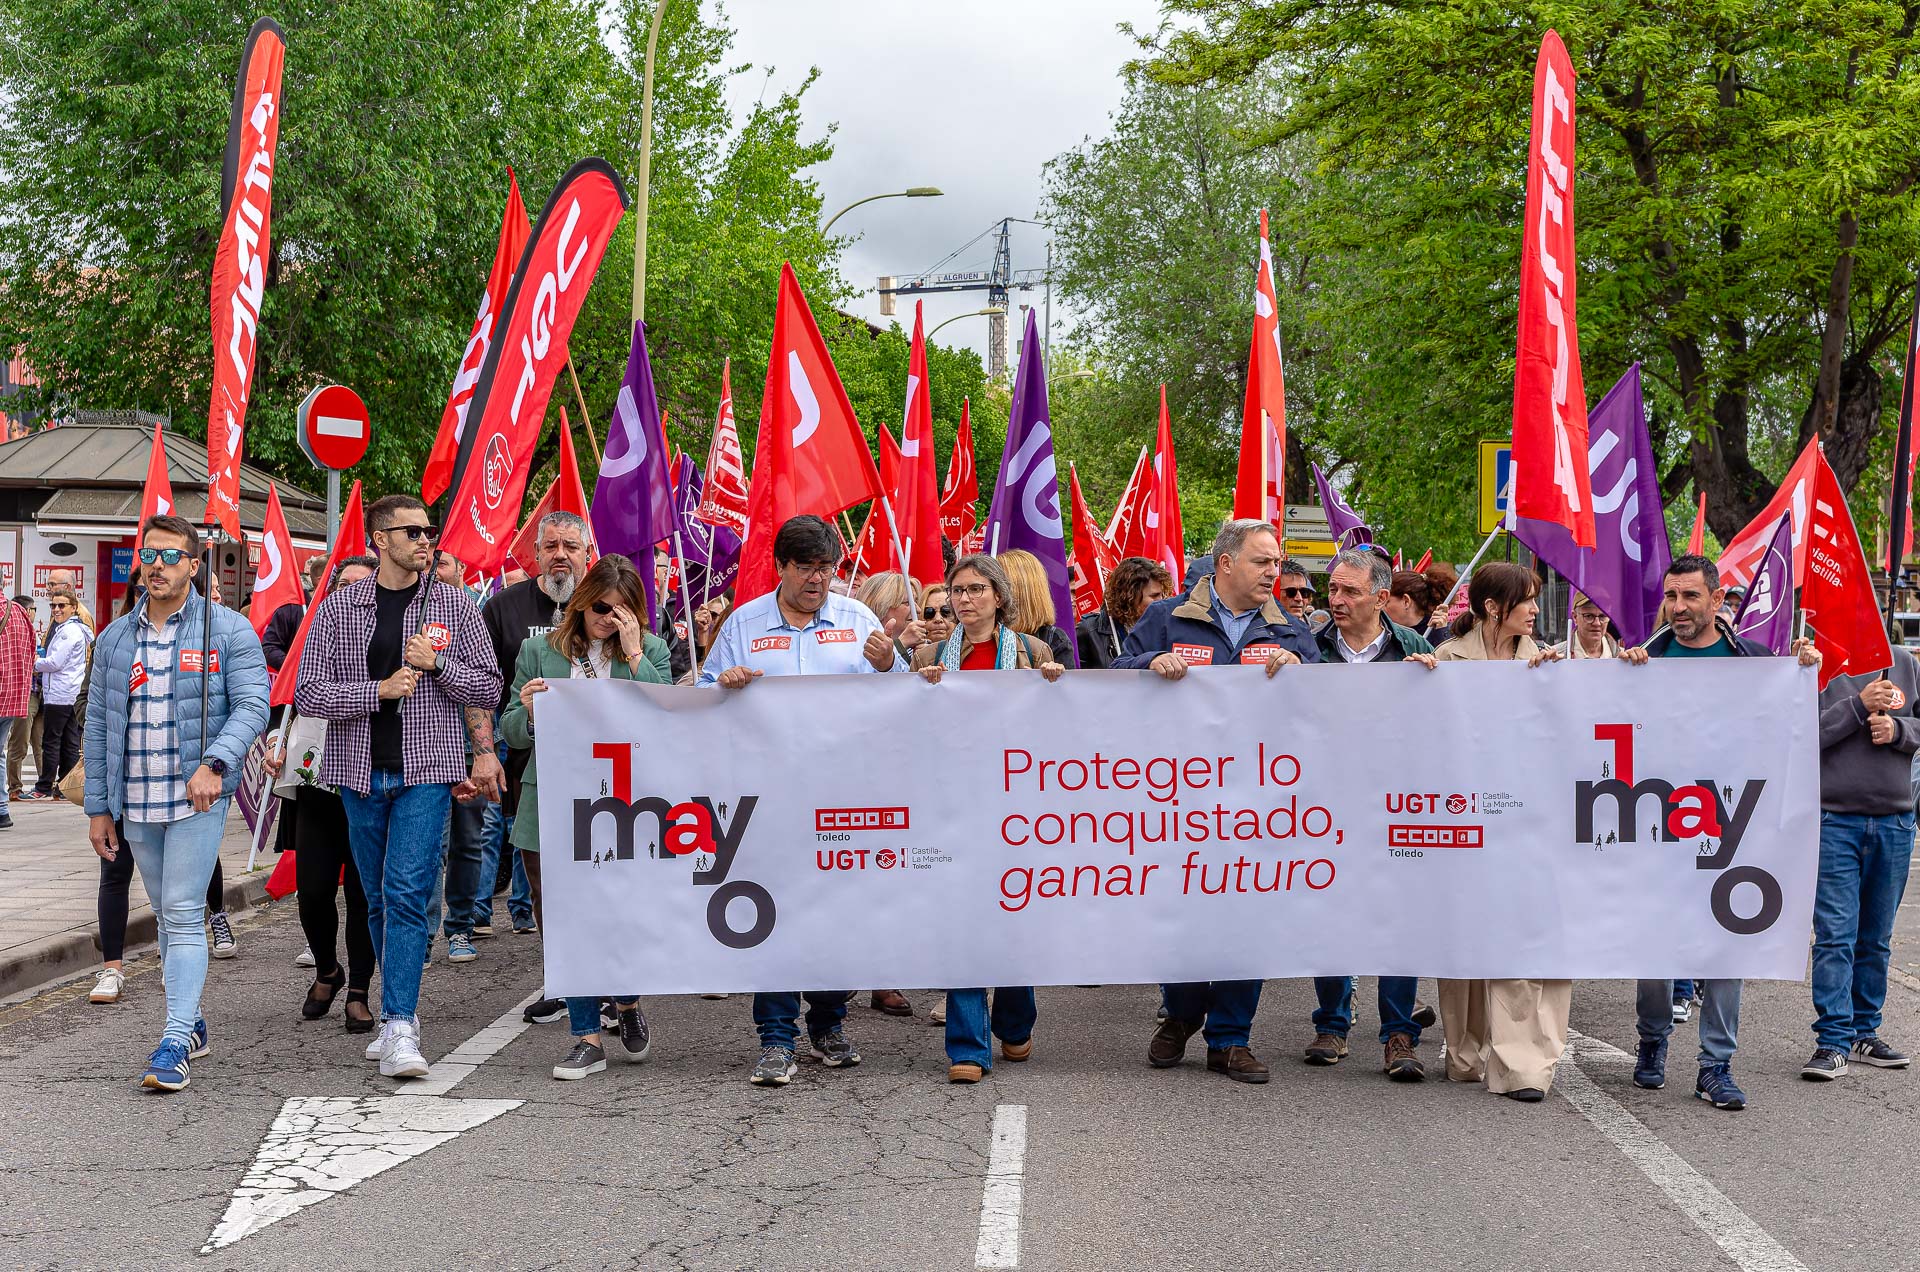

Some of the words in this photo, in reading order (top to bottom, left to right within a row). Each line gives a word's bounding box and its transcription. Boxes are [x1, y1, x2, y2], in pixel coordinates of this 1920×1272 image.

[943, 272, 979, 281] ALGRUEN
[510, 197, 589, 426] UGT
[470, 496, 495, 544] Toledo
[428, 628, 448, 641] UGT
[816, 631, 842, 642] UGT
[752, 638, 777, 650] UGT
[182, 653, 217, 663] CCO
[1173, 647, 1211, 659] CCOO
[1003, 748, 1235, 803] Proteger
[1258, 742, 1302, 787] lo
[1482, 792, 1513, 800] Castilla-
[1385, 793, 1441, 814] UGT
[1482, 800, 1492, 808] La
[1493, 800, 1524, 808] Mancha
[820, 811, 880, 828] CCOO
[1000, 794, 1345, 856] conquistado,
[815, 832, 851, 842] Toledo
[1393, 828, 1454, 844] CCOO
[911, 847, 943, 855] Castilla-
[1388, 848, 1424, 858] Toledo
[816, 849, 871, 871] UGT
[911, 855, 921, 863] La
[922, 855, 953, 863] Mancha
[999, 864, 1160, 913] ganar
[1181, 851, 1337, 895] futuro
